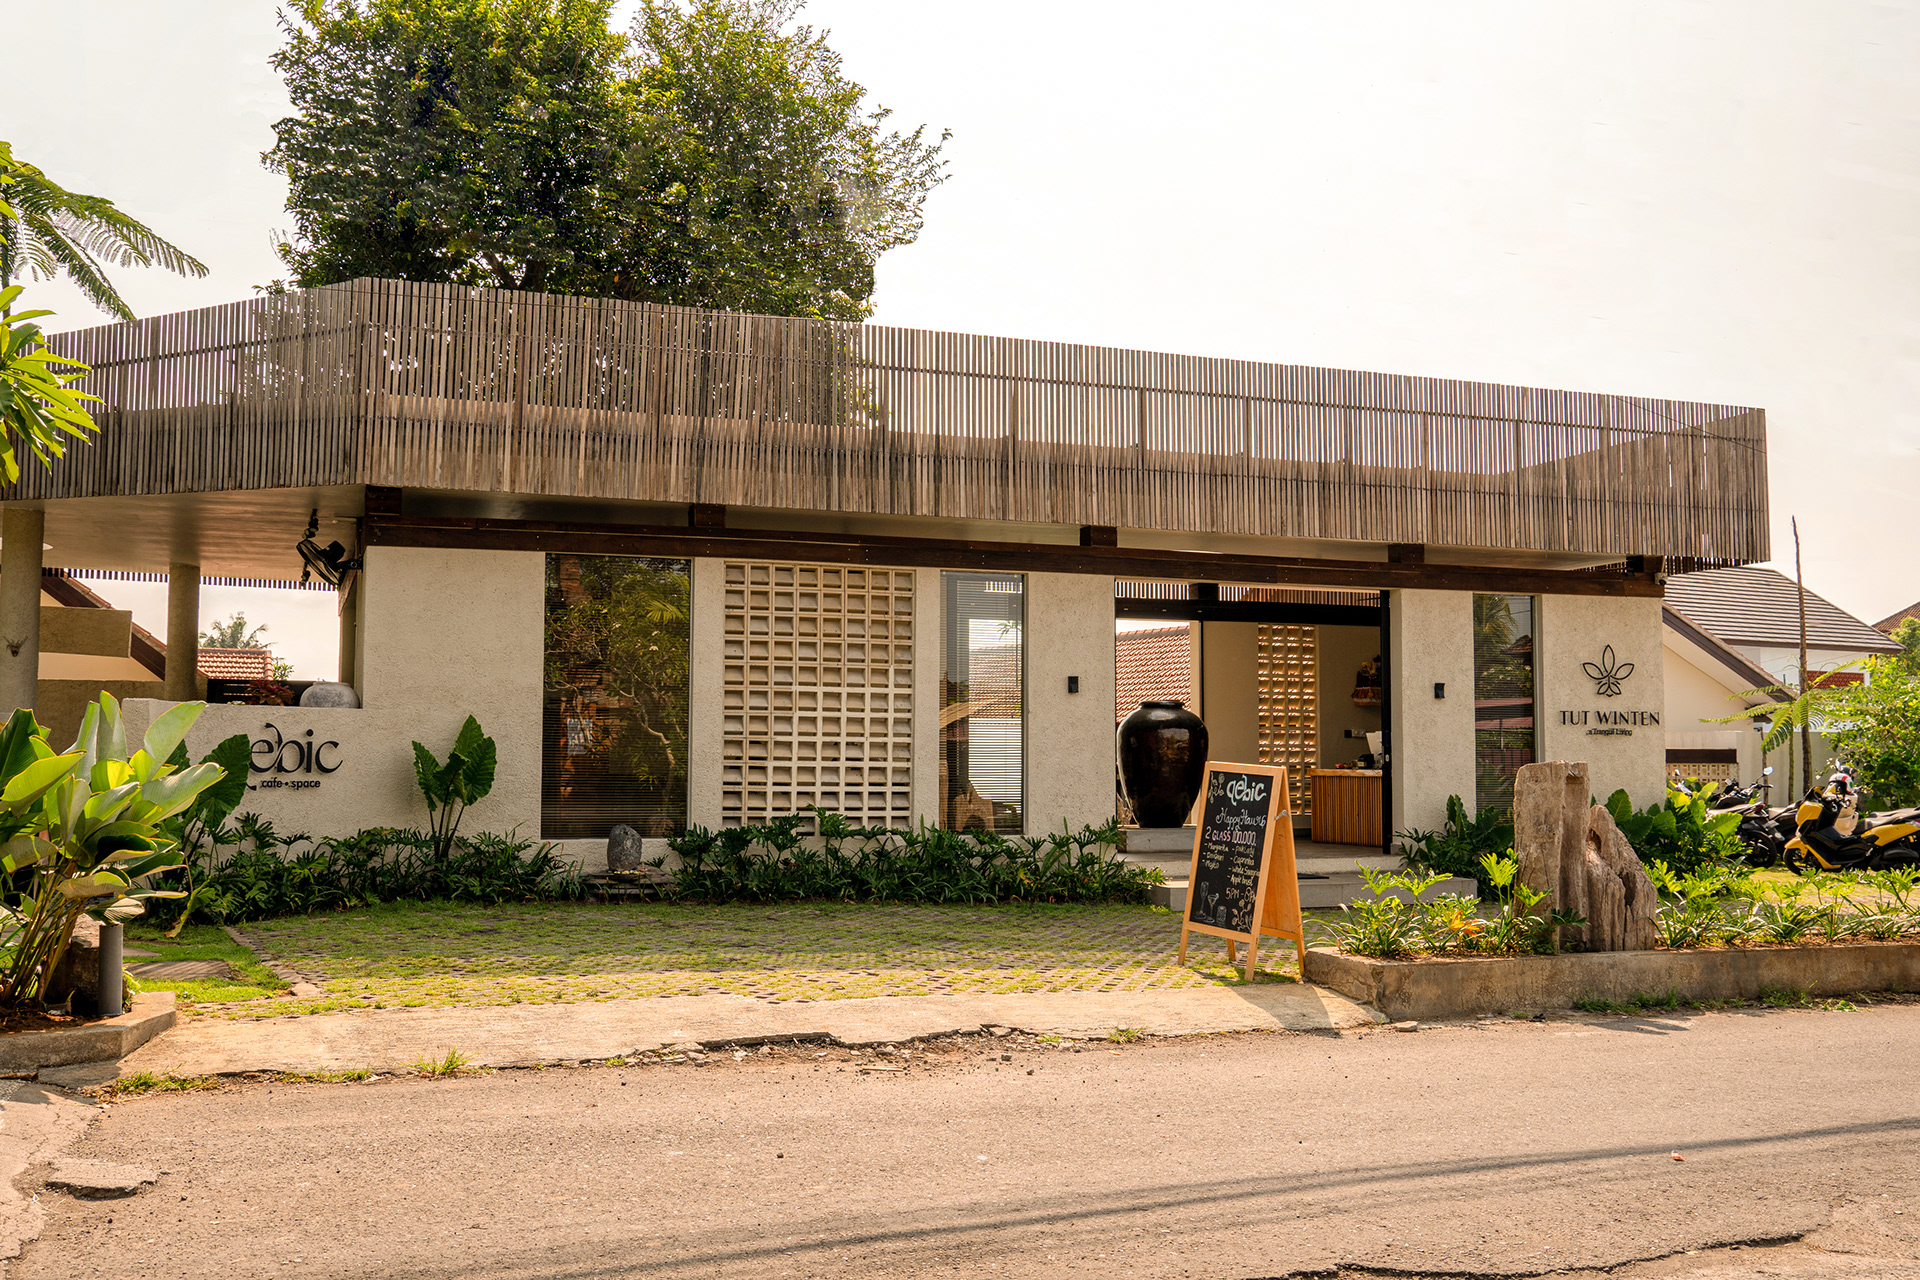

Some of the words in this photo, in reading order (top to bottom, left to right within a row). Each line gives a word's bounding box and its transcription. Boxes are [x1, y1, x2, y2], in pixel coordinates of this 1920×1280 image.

[1560, 710, 1590, 726] TUT
[1596, 710, 1660, 727] WINTEN
[246, 722, 343, 791] ebic
[261, 776, 283, 788] cafe
[291, 780, 321, 790] space
[1215, 807, 1241, 832] Happy
[1205, 826, 1212, 839] 2
[1212, 829, 1231, 842] GLASS
